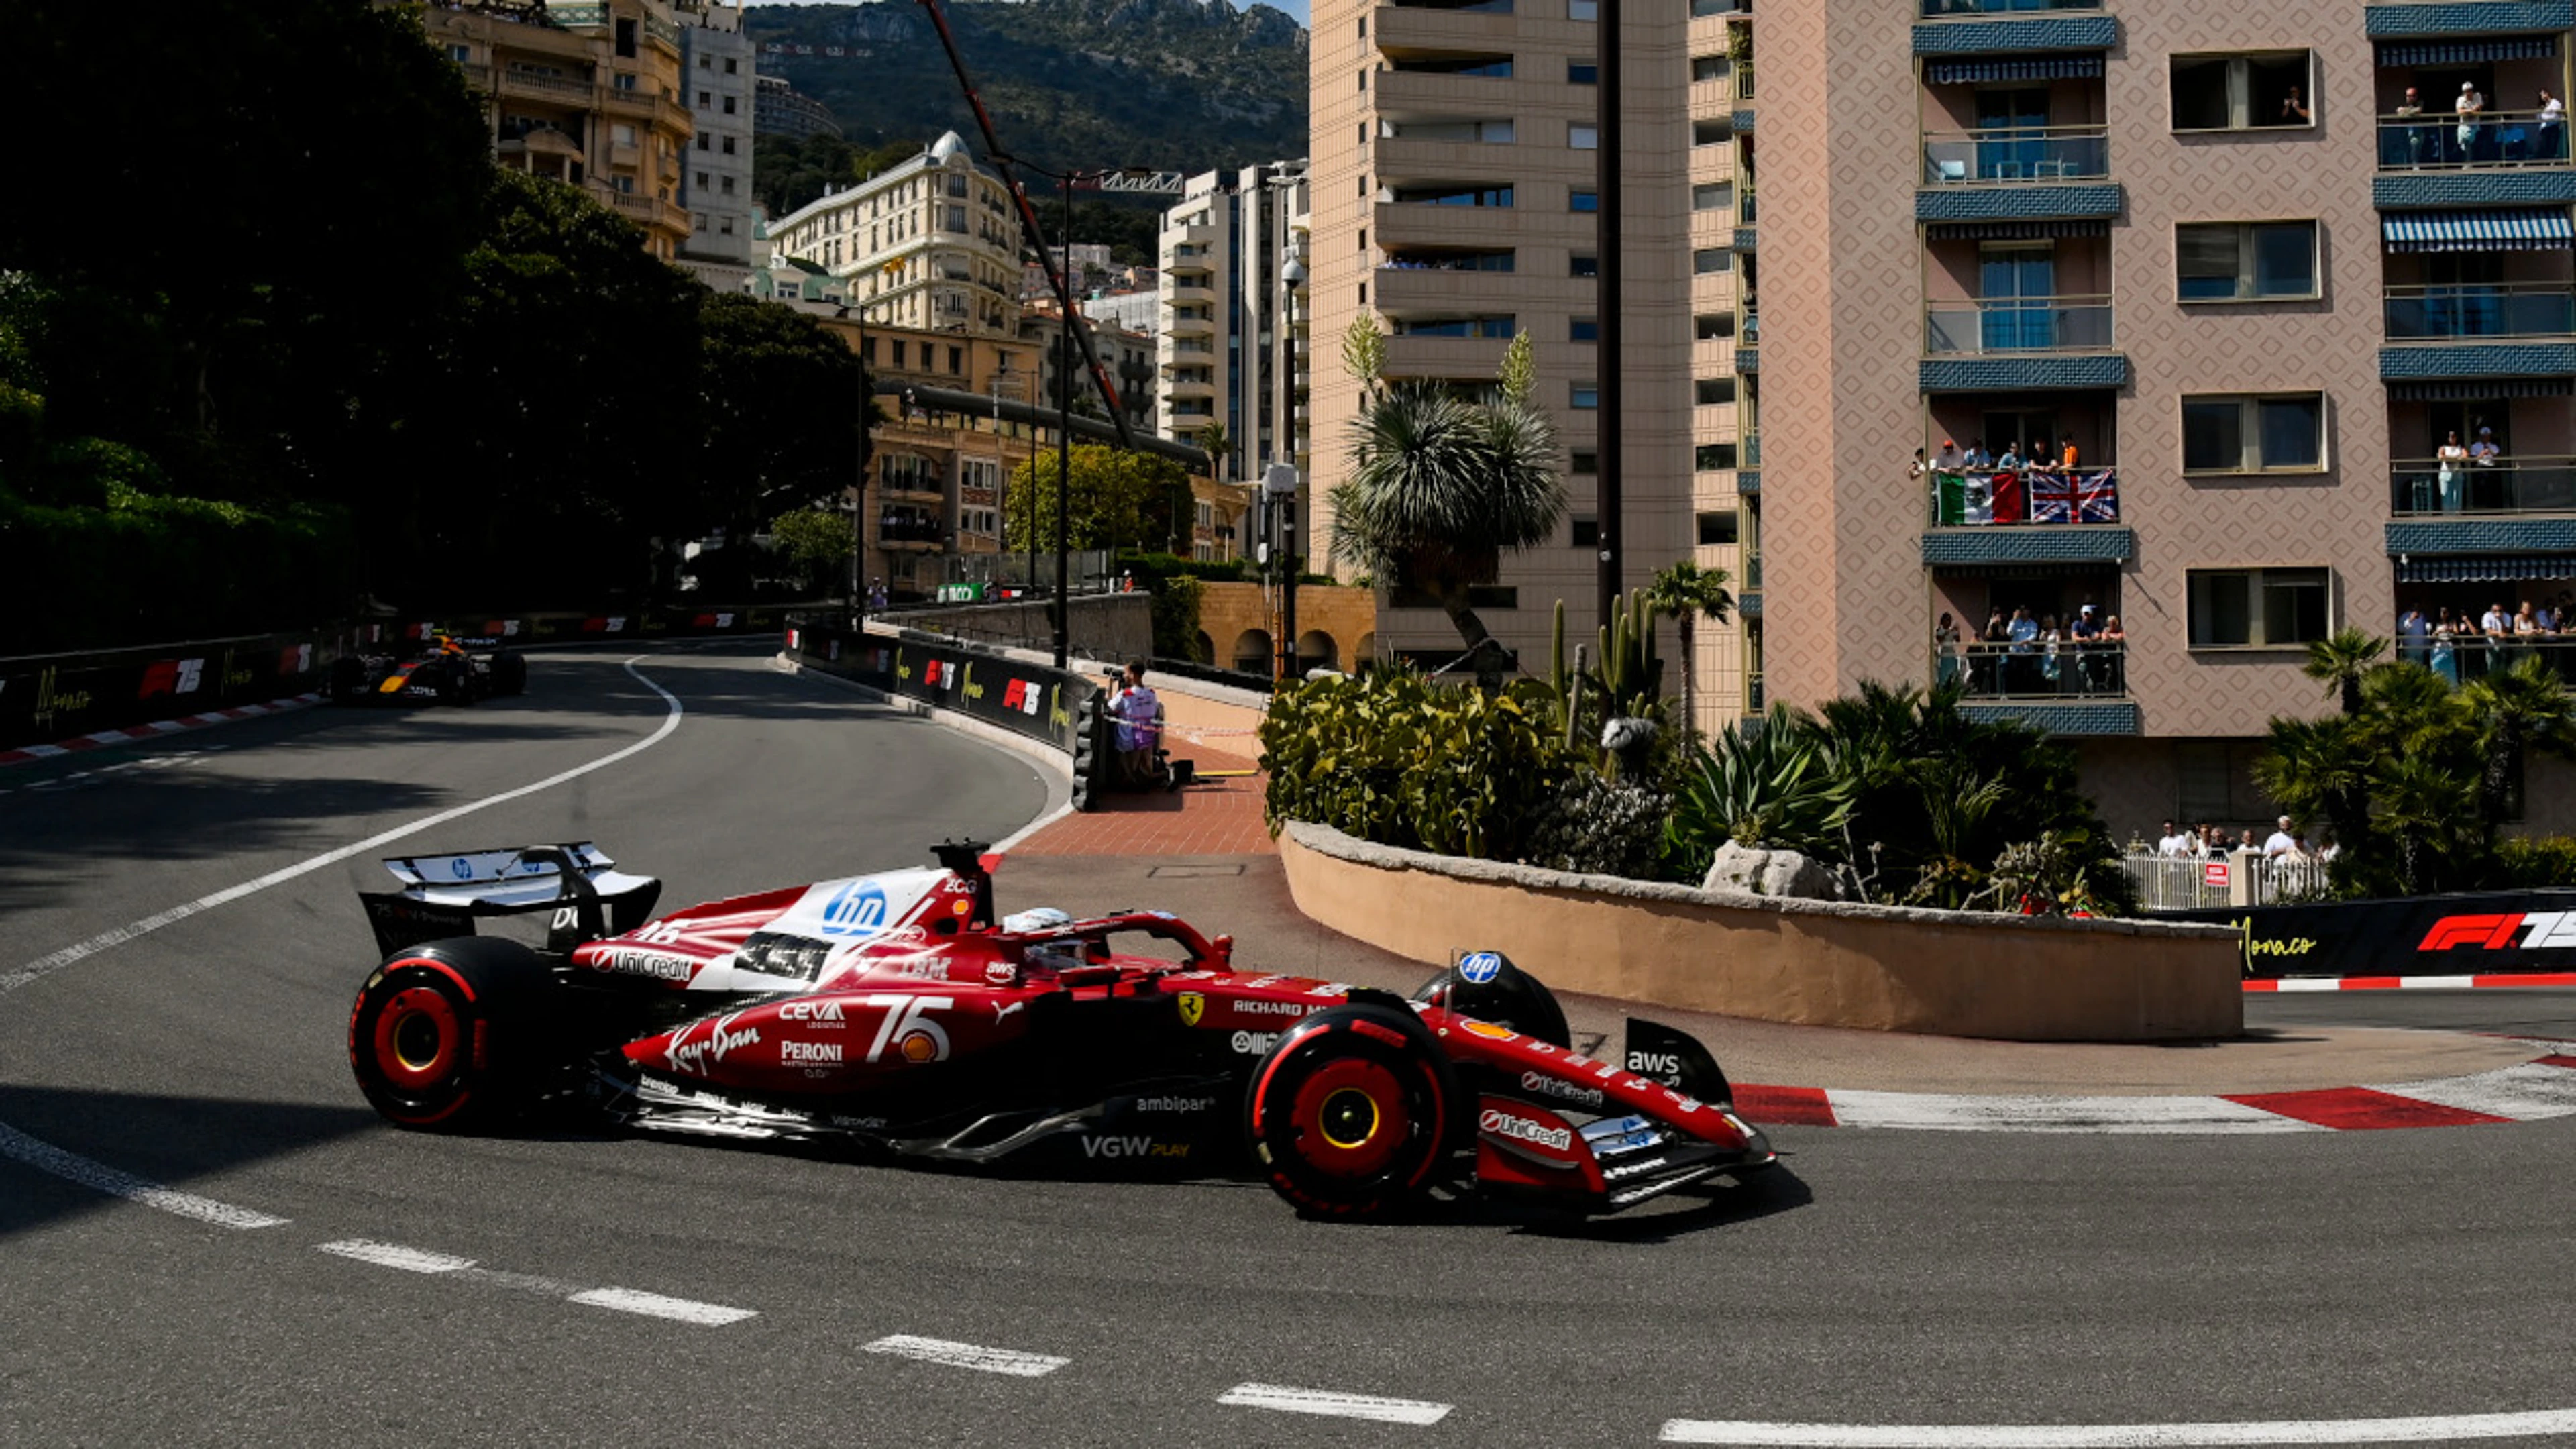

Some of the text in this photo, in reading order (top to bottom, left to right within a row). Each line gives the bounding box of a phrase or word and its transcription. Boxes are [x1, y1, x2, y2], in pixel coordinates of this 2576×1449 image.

[615, 951, 691, 980] UniCredit
[1232, 1000, 1303, 1016] RICHARD
[865, 994, 954, 1063] 75
[781, 1040, 843, 1061] PERONI
[1627, 1051, 1680, 1074] aws
[1136, 1095, 1208, 1116] ambipar
[1500, 1113, 1572, 1151] UniCredit
[1081, 1135, 1152, 1159] VGW
